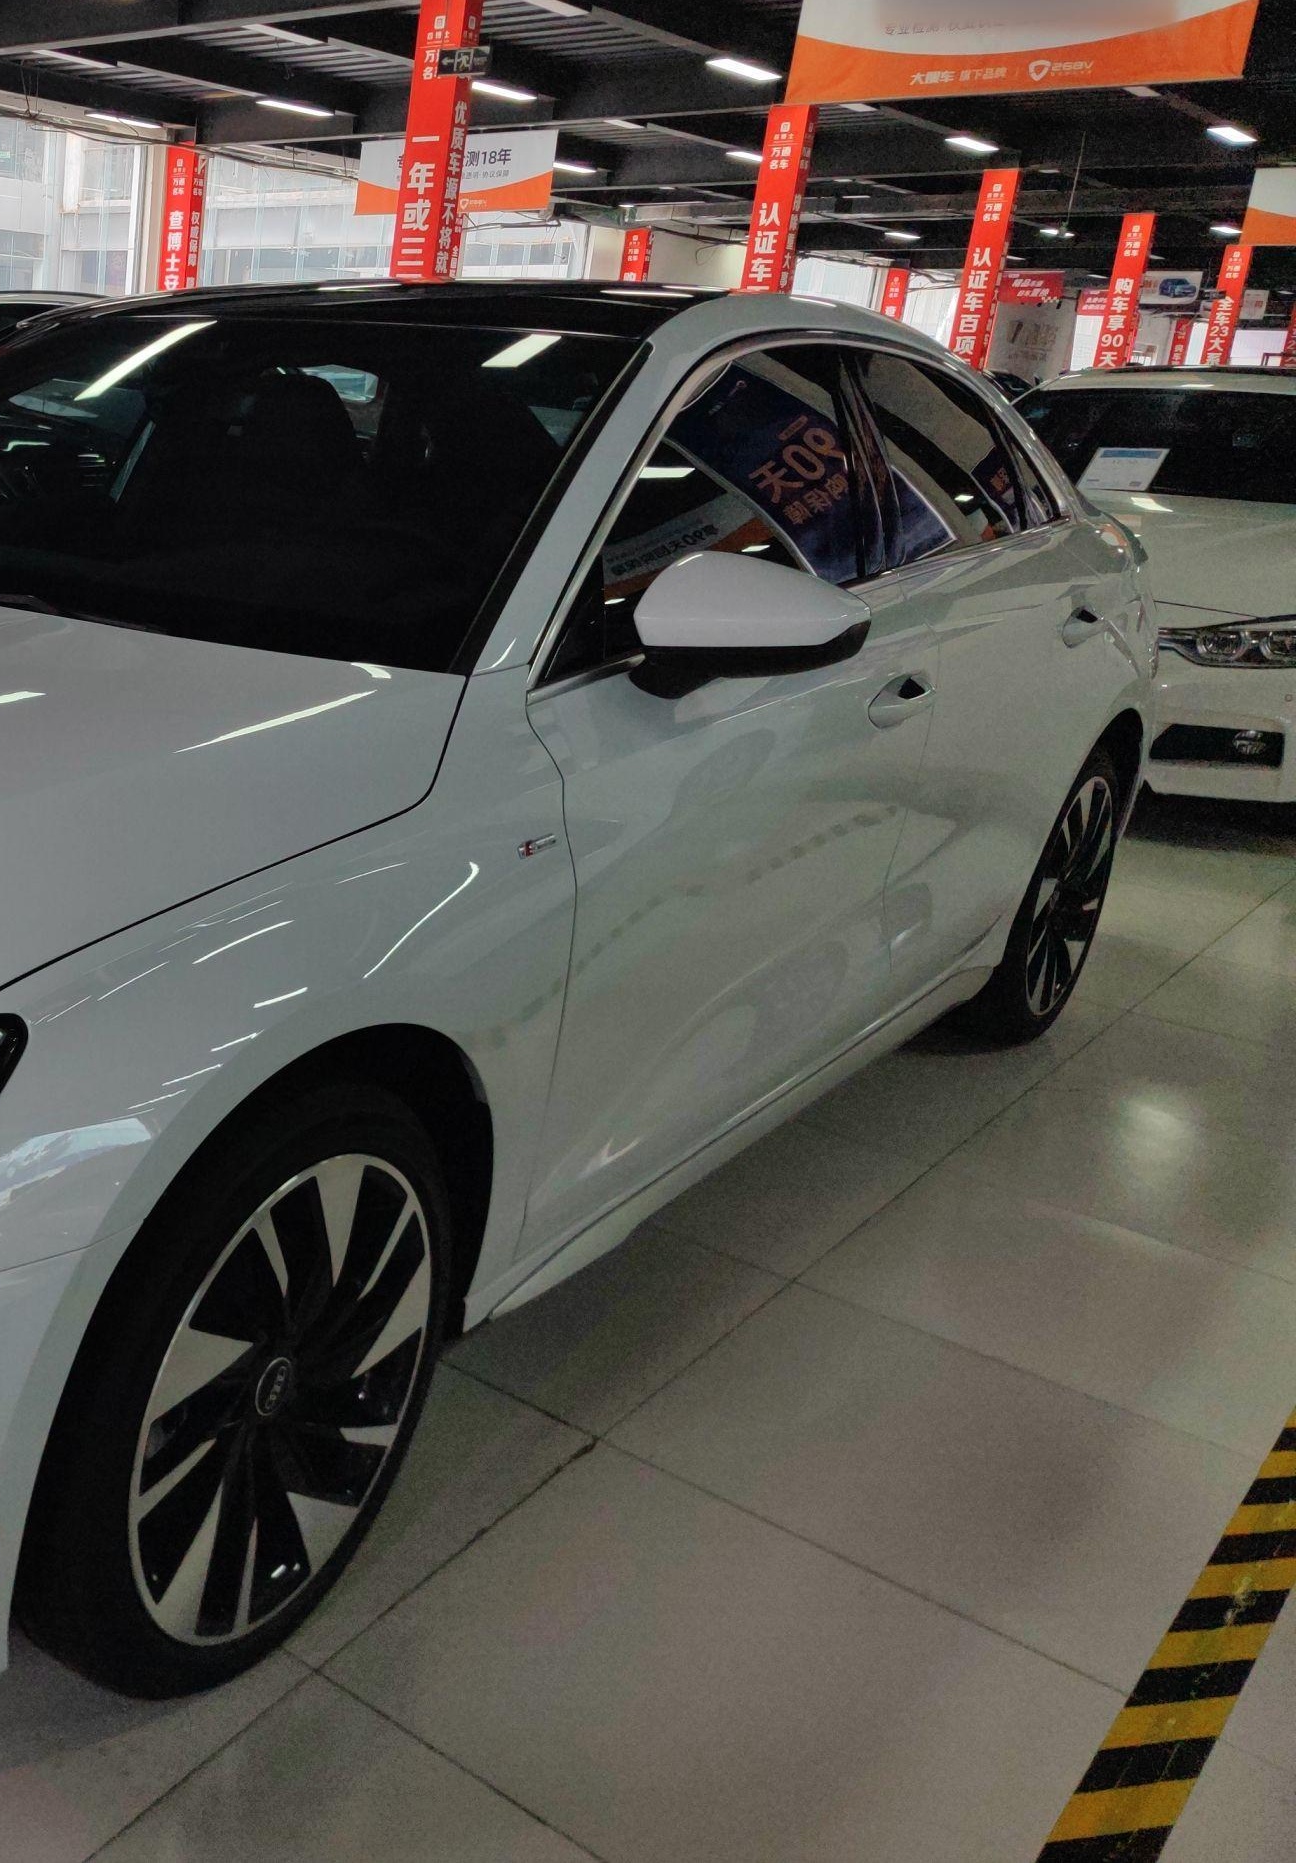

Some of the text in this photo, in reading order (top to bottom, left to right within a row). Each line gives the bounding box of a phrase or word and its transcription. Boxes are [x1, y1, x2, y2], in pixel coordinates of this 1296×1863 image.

[435, 101, 468, 274] 优质车源不将就
[769, 159, 790, 170] 名车
[771, 146, 792, 157] 万通
[395, 135, 440, 278] 一年或三
[747, 202, 781, 291] 认证车
[778, 193, 802, 293] 排除重大事
[982, 213, 1000, 222] 名车
[984, 202, 1002, 212] 万通
[1098, 278, 1135, 368] 购车享90天
